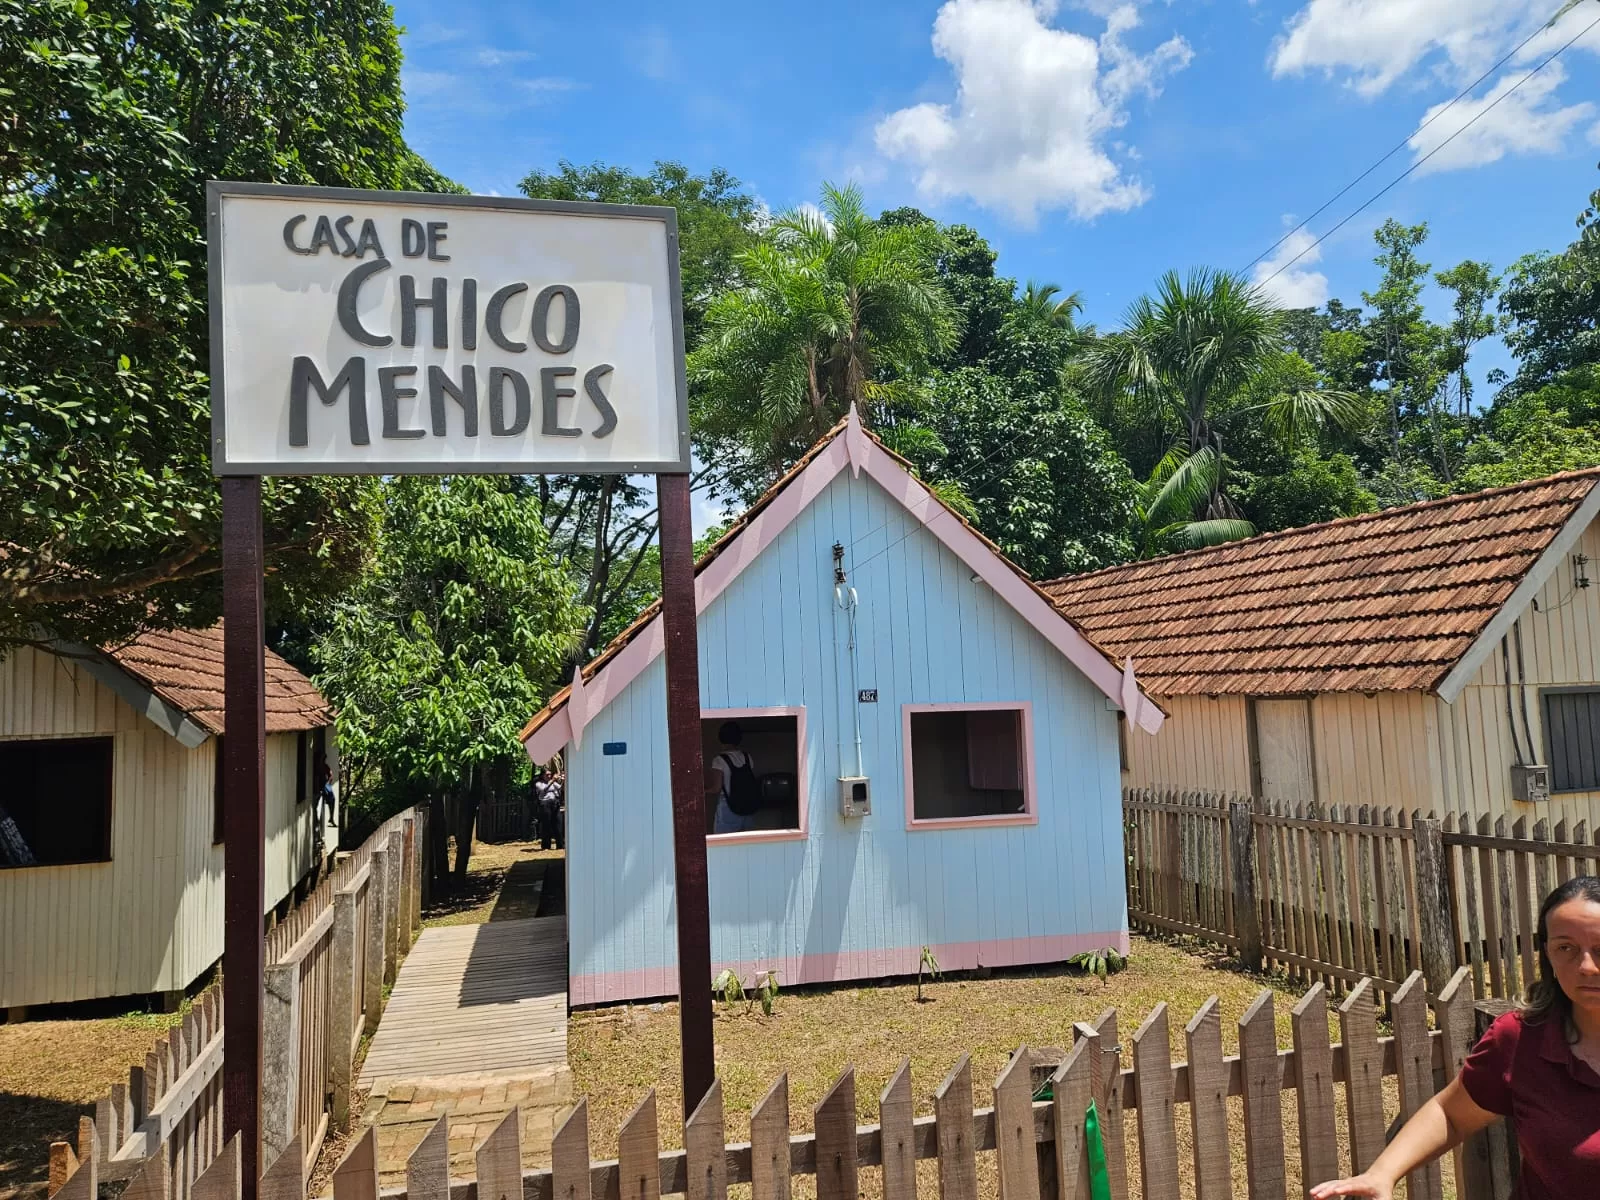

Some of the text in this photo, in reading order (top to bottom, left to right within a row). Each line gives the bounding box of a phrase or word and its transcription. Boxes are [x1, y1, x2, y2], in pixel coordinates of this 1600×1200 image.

[284, 215, 450, 261] CASA DE
[338, 259, 580, 353] CHICO
[289, 356, 618, 446] MENDES
[861, 691, 875, 701] 487
